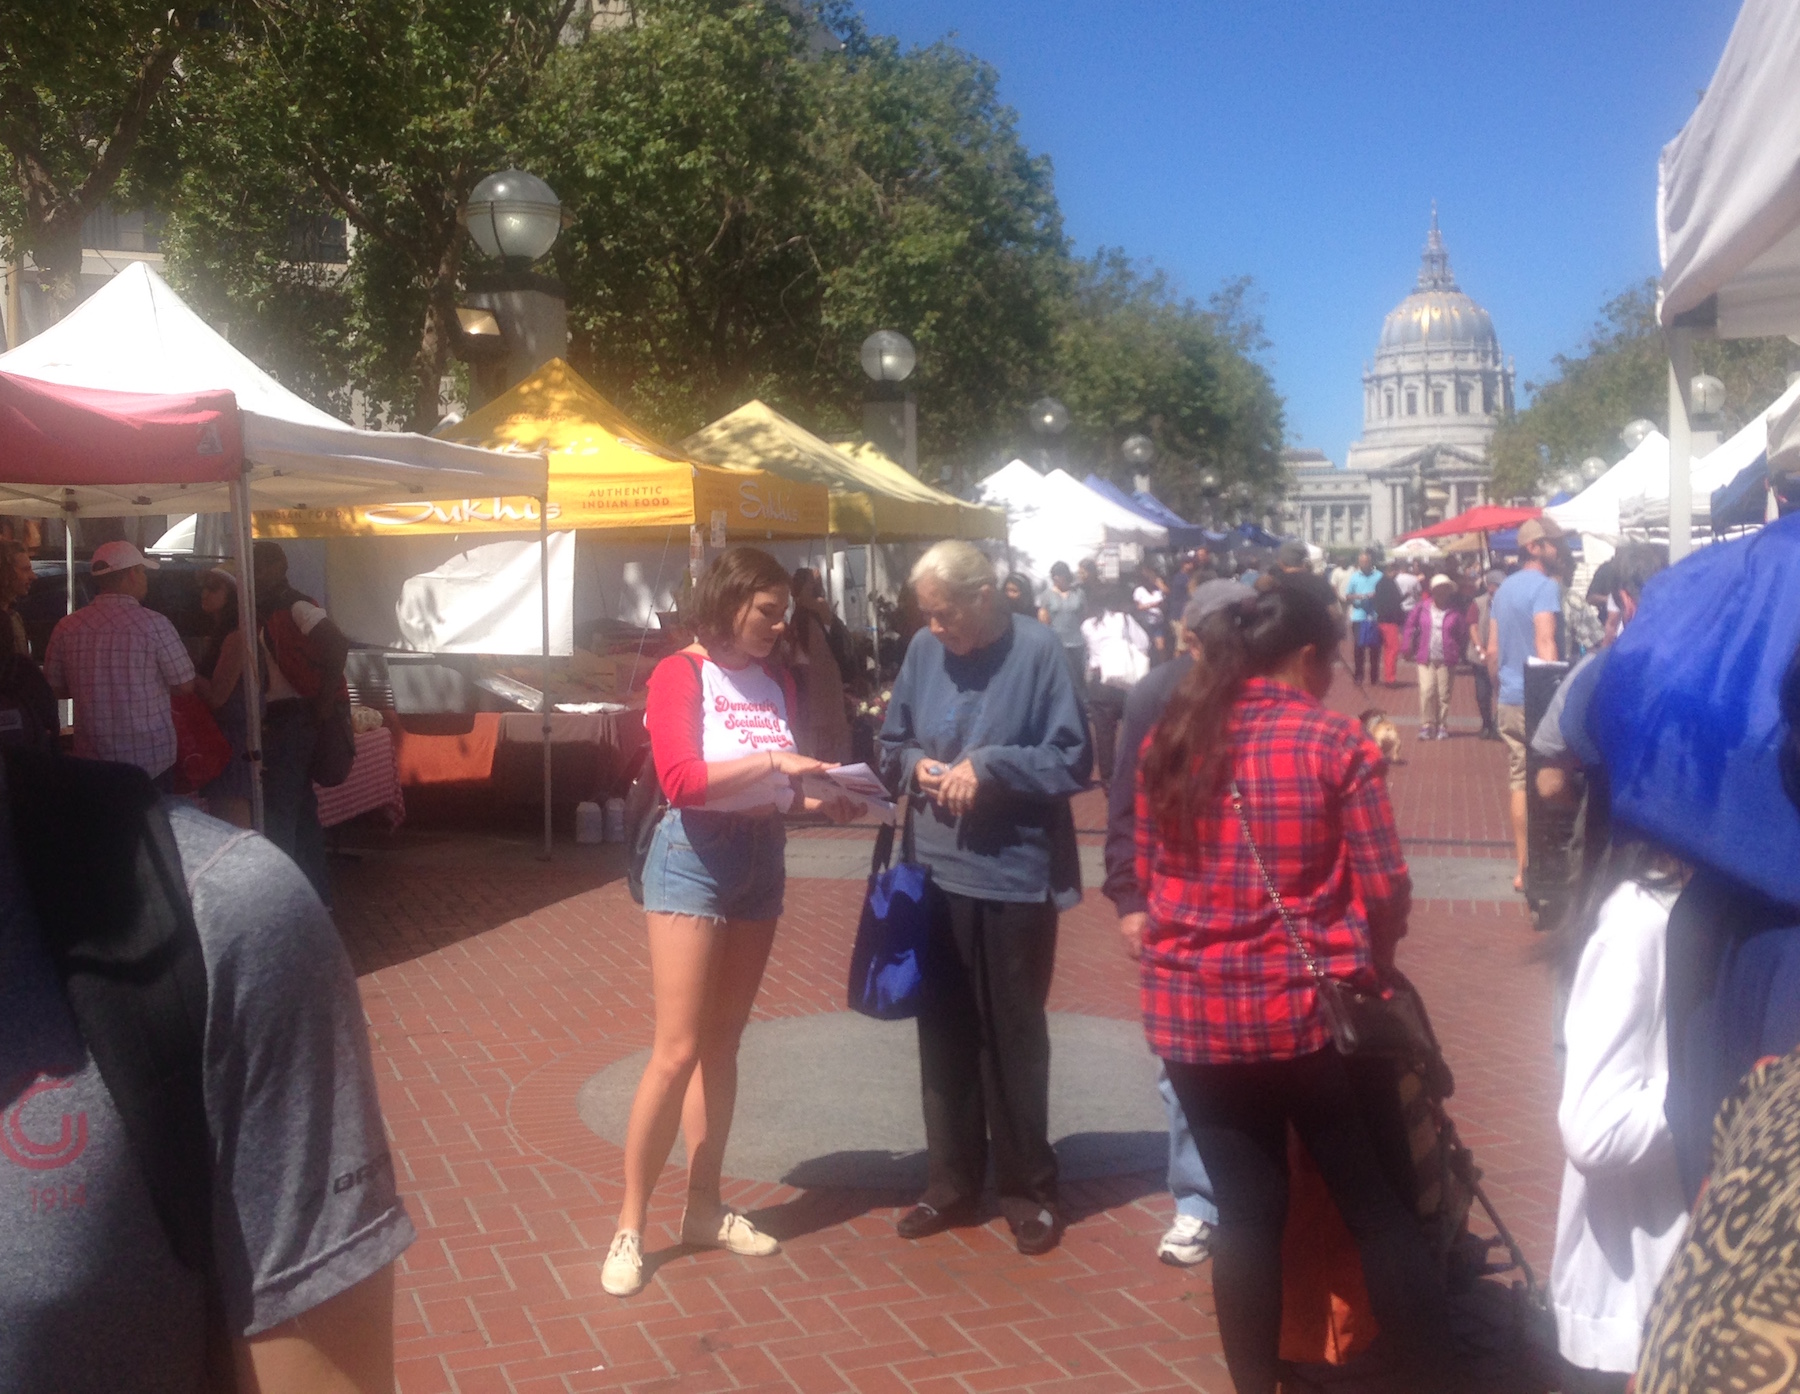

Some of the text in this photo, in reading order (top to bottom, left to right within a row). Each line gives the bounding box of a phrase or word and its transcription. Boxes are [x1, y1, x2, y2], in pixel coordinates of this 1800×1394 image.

[588, 485, 663, 498] AUTHENTIC
[582, 497, 671, 509] INDIAN FOOD
[724, 713, 773, 730] Socialists
[738, 729, 794, 749] America
[28, 1183, 88, 1214] 1914
